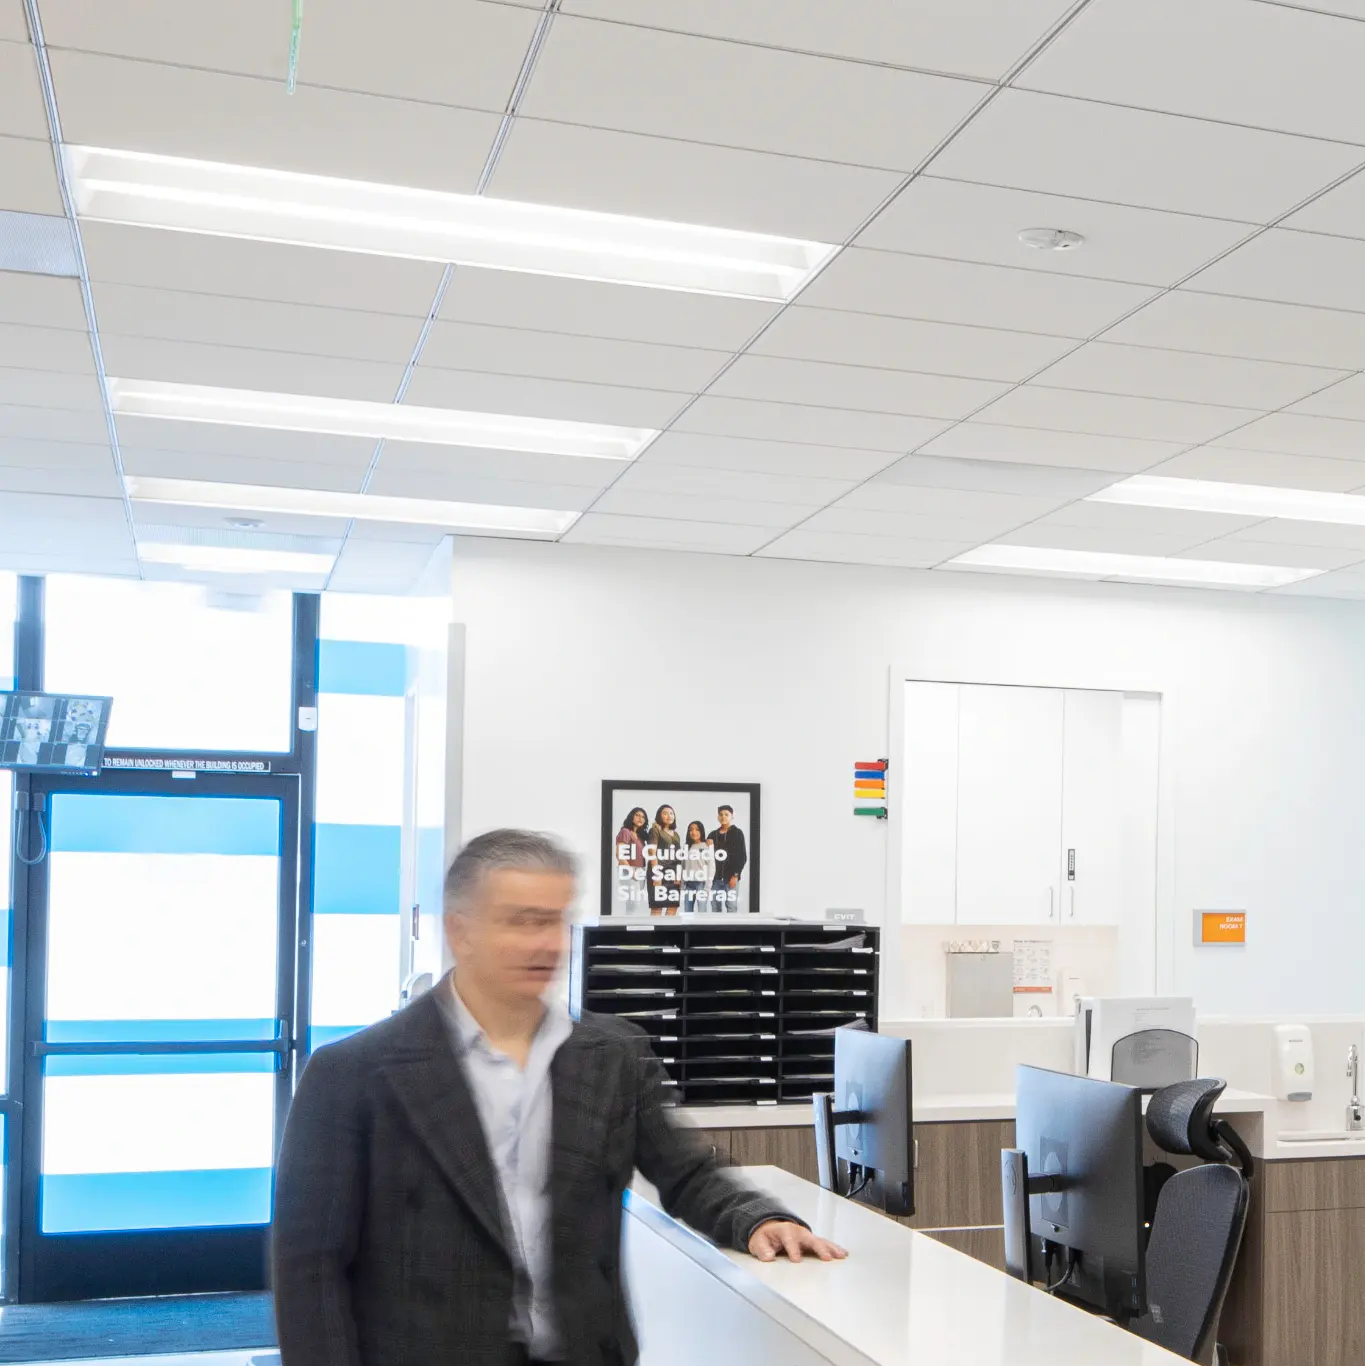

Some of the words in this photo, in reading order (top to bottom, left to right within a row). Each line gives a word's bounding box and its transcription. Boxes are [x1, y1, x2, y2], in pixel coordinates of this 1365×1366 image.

[104, 757, 112, 767] TO
[112, 757, 134, 768] REMAIN
[134, 758, 164, 769] UNLOCKED
[164, 759, 195, 770] WHENEVER
[195, 760, 206, 769] THE
[205, 760, 231, 770] BUILDING
[231, 760, 238, 770] IS
[237, 761, 265, 771] OCCUPIED
[618, 843, 637, 861] El
[642, 843, 728, 861] Cuidado
[618, 864, 647, 881] De
[617, 885, 649, 902] Sin
